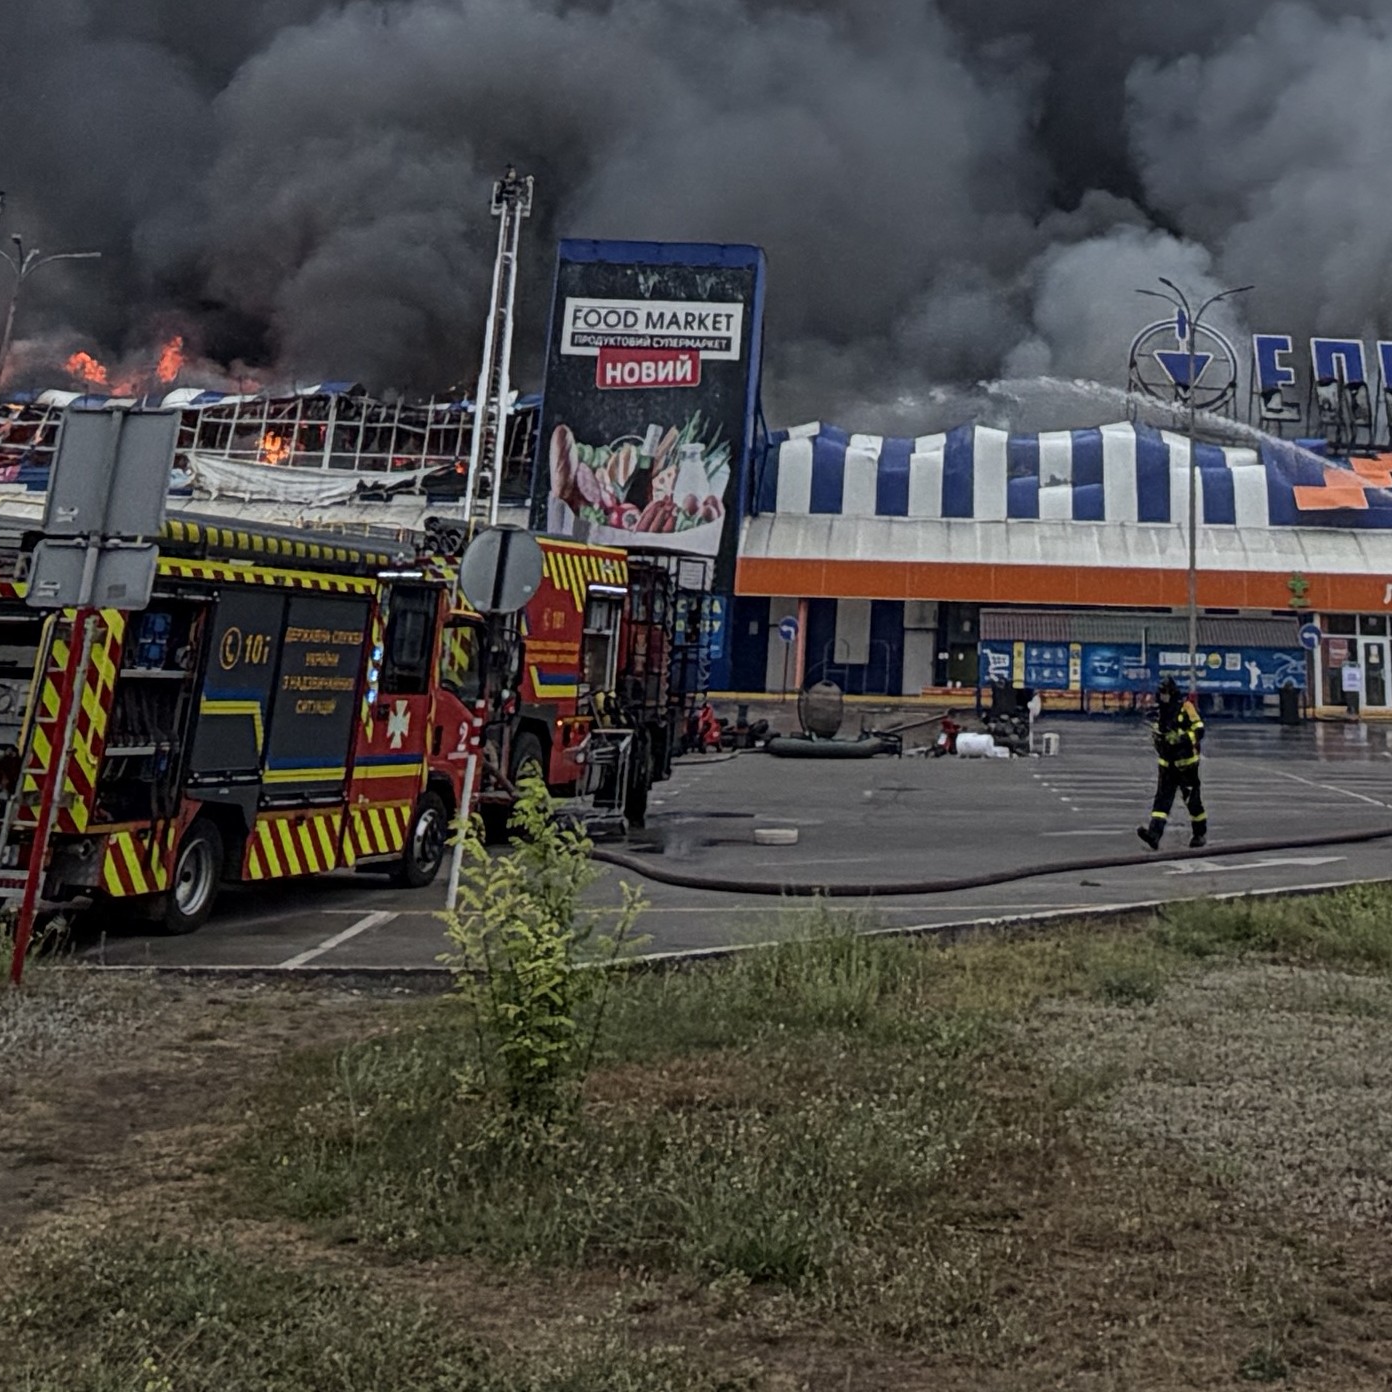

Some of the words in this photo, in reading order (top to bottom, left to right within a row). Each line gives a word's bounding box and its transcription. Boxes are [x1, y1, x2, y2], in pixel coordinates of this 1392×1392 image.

[571, 309, 639, 328] FOOD
[645, 311, 735, 332] MARKET
[573, 334, 651, 348] ПРОДУКТОВИЙ
[652, 336, 727, 349] СУПЕРМАРКЕТ
[605, 354, 693, 385] НОВИЙ
